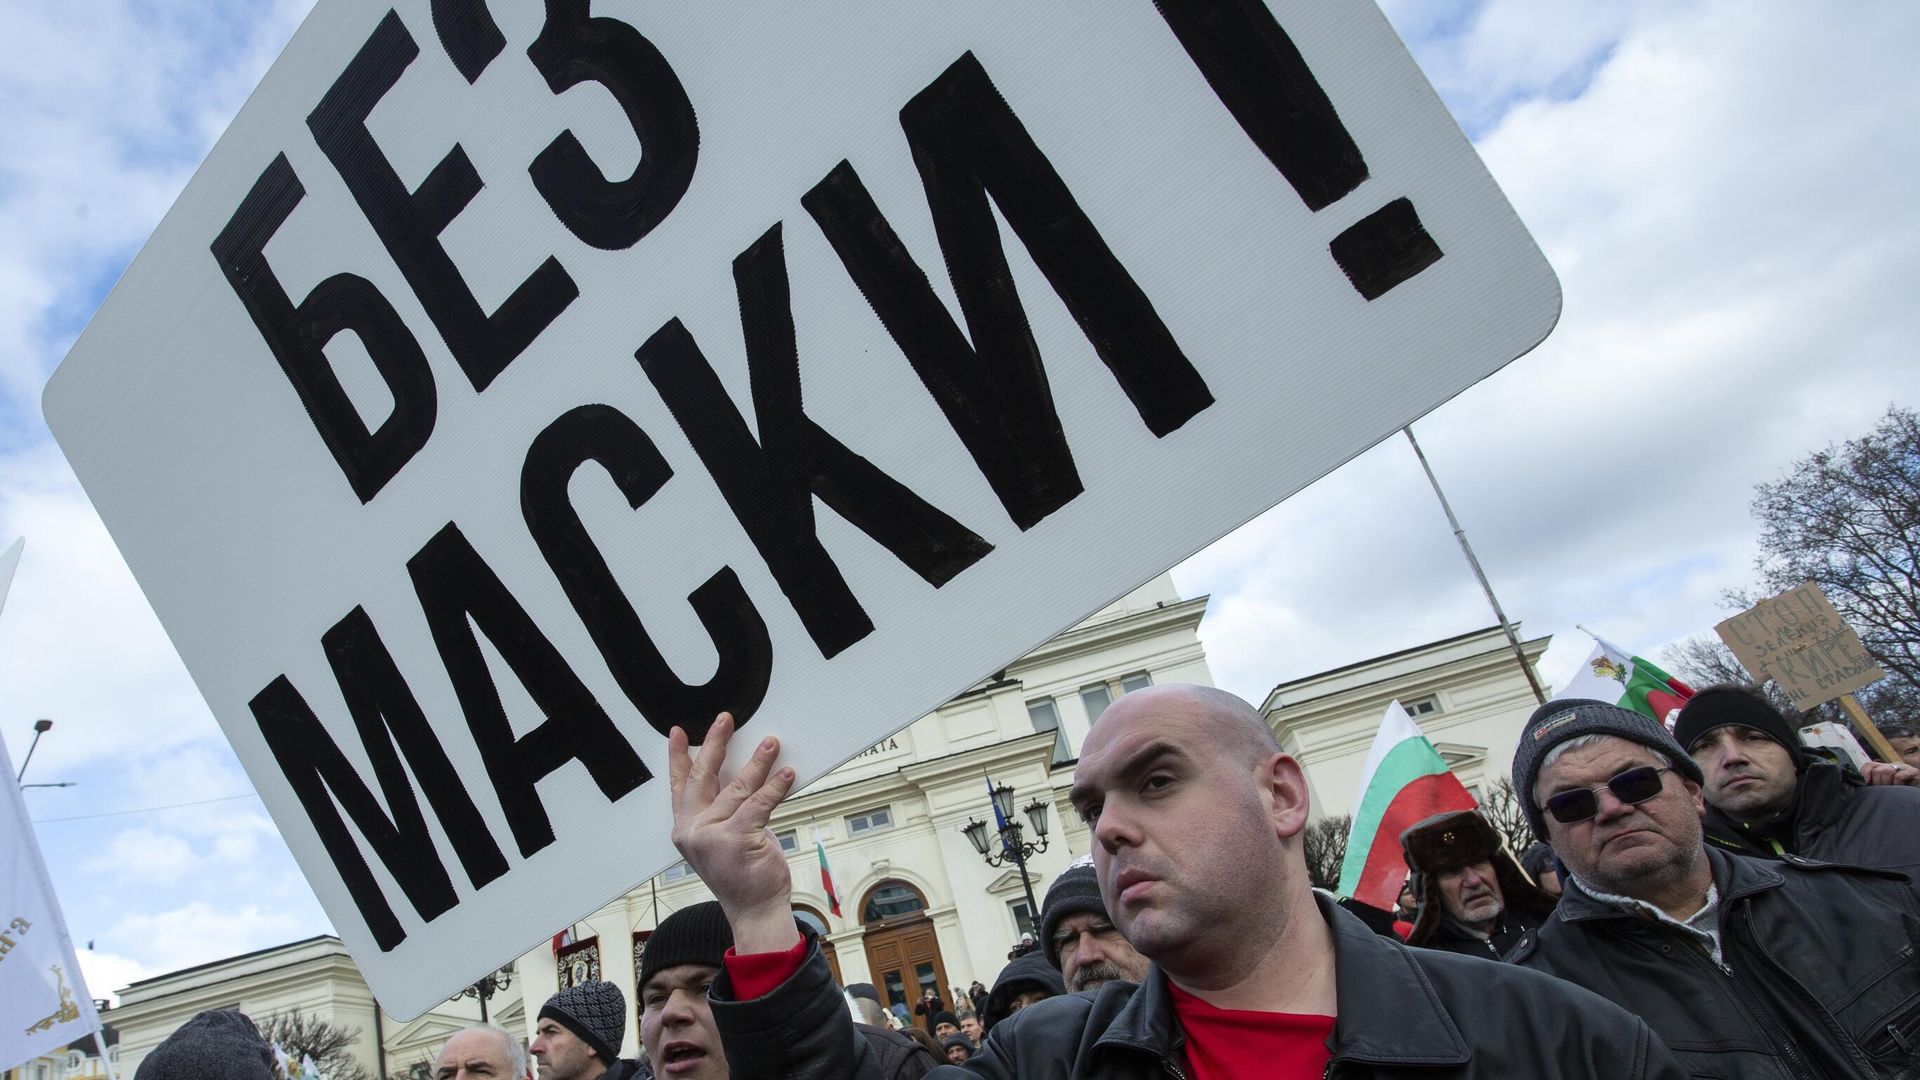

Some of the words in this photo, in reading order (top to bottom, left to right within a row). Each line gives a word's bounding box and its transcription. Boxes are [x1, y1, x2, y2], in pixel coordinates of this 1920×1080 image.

[211, 0, 699, 503] БЕЗ
[249, 50, 1215, 952] МАСКИ
[1728, 588, 1823, 646] СТОП
[1776, 632, 1862, 686] КИРЕ
[1788, 686, 1810, 702] НЕ
